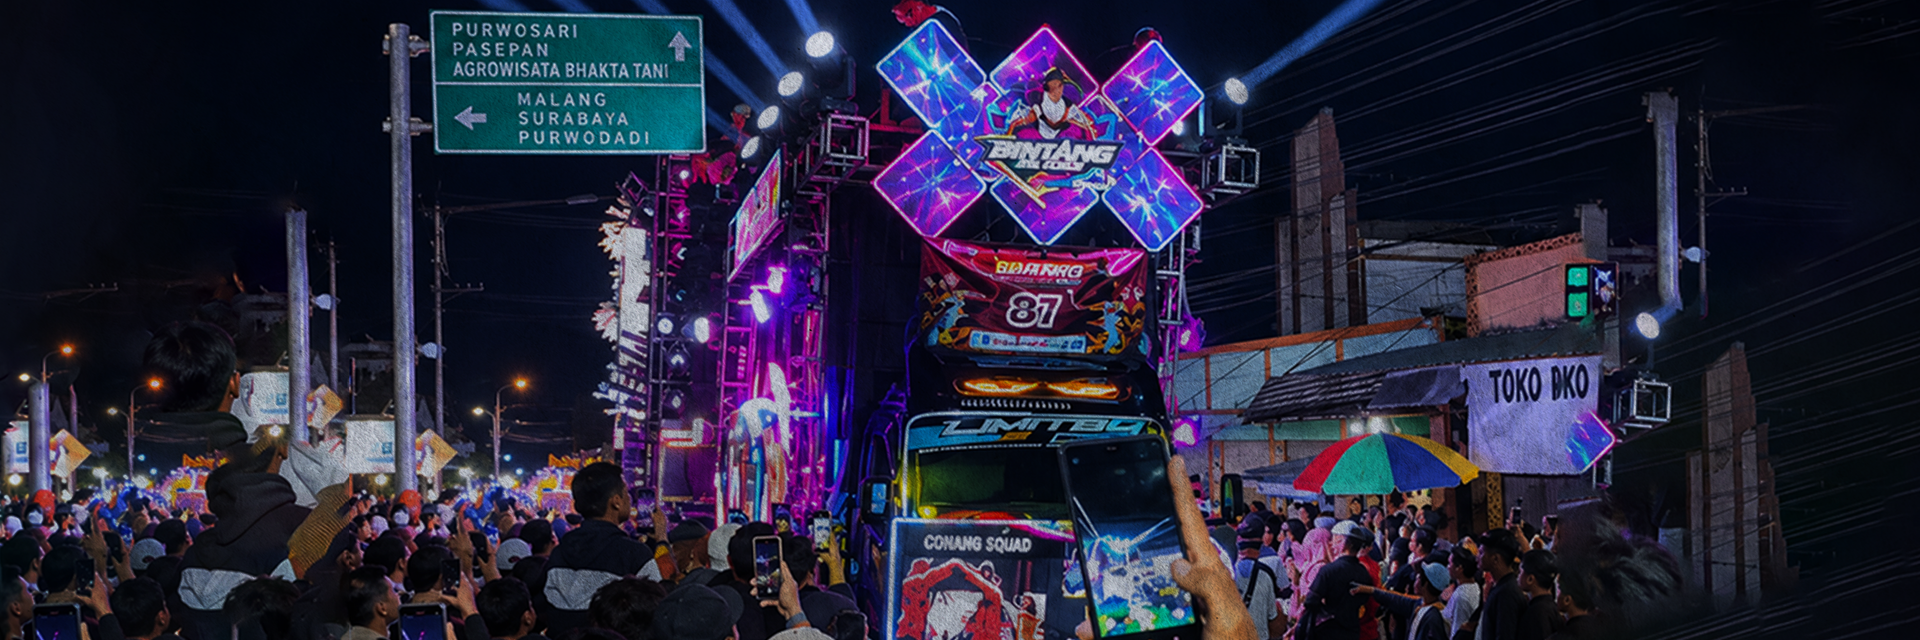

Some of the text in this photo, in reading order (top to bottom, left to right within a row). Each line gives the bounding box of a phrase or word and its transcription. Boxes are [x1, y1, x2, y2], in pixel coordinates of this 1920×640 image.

[452, 22, 578, 38] PURWOSARI
[453, 42, 549, 57] PASEPAN
[453, 61, 669, 79] AGROWISATA BHAKTA TANI
[517, 92, 607, 107] MALANG
[518, 111, 629, 126] SURABAYA
[518, 131, 650, 145] PURWODADI
[987, 139, 1119, 164] BINTANG
[1006, 291, 1063, 329] 87
[1488, 366, 1542, 403] TOKO
[923, 533, 1032, 554] CONANG SQUAD
